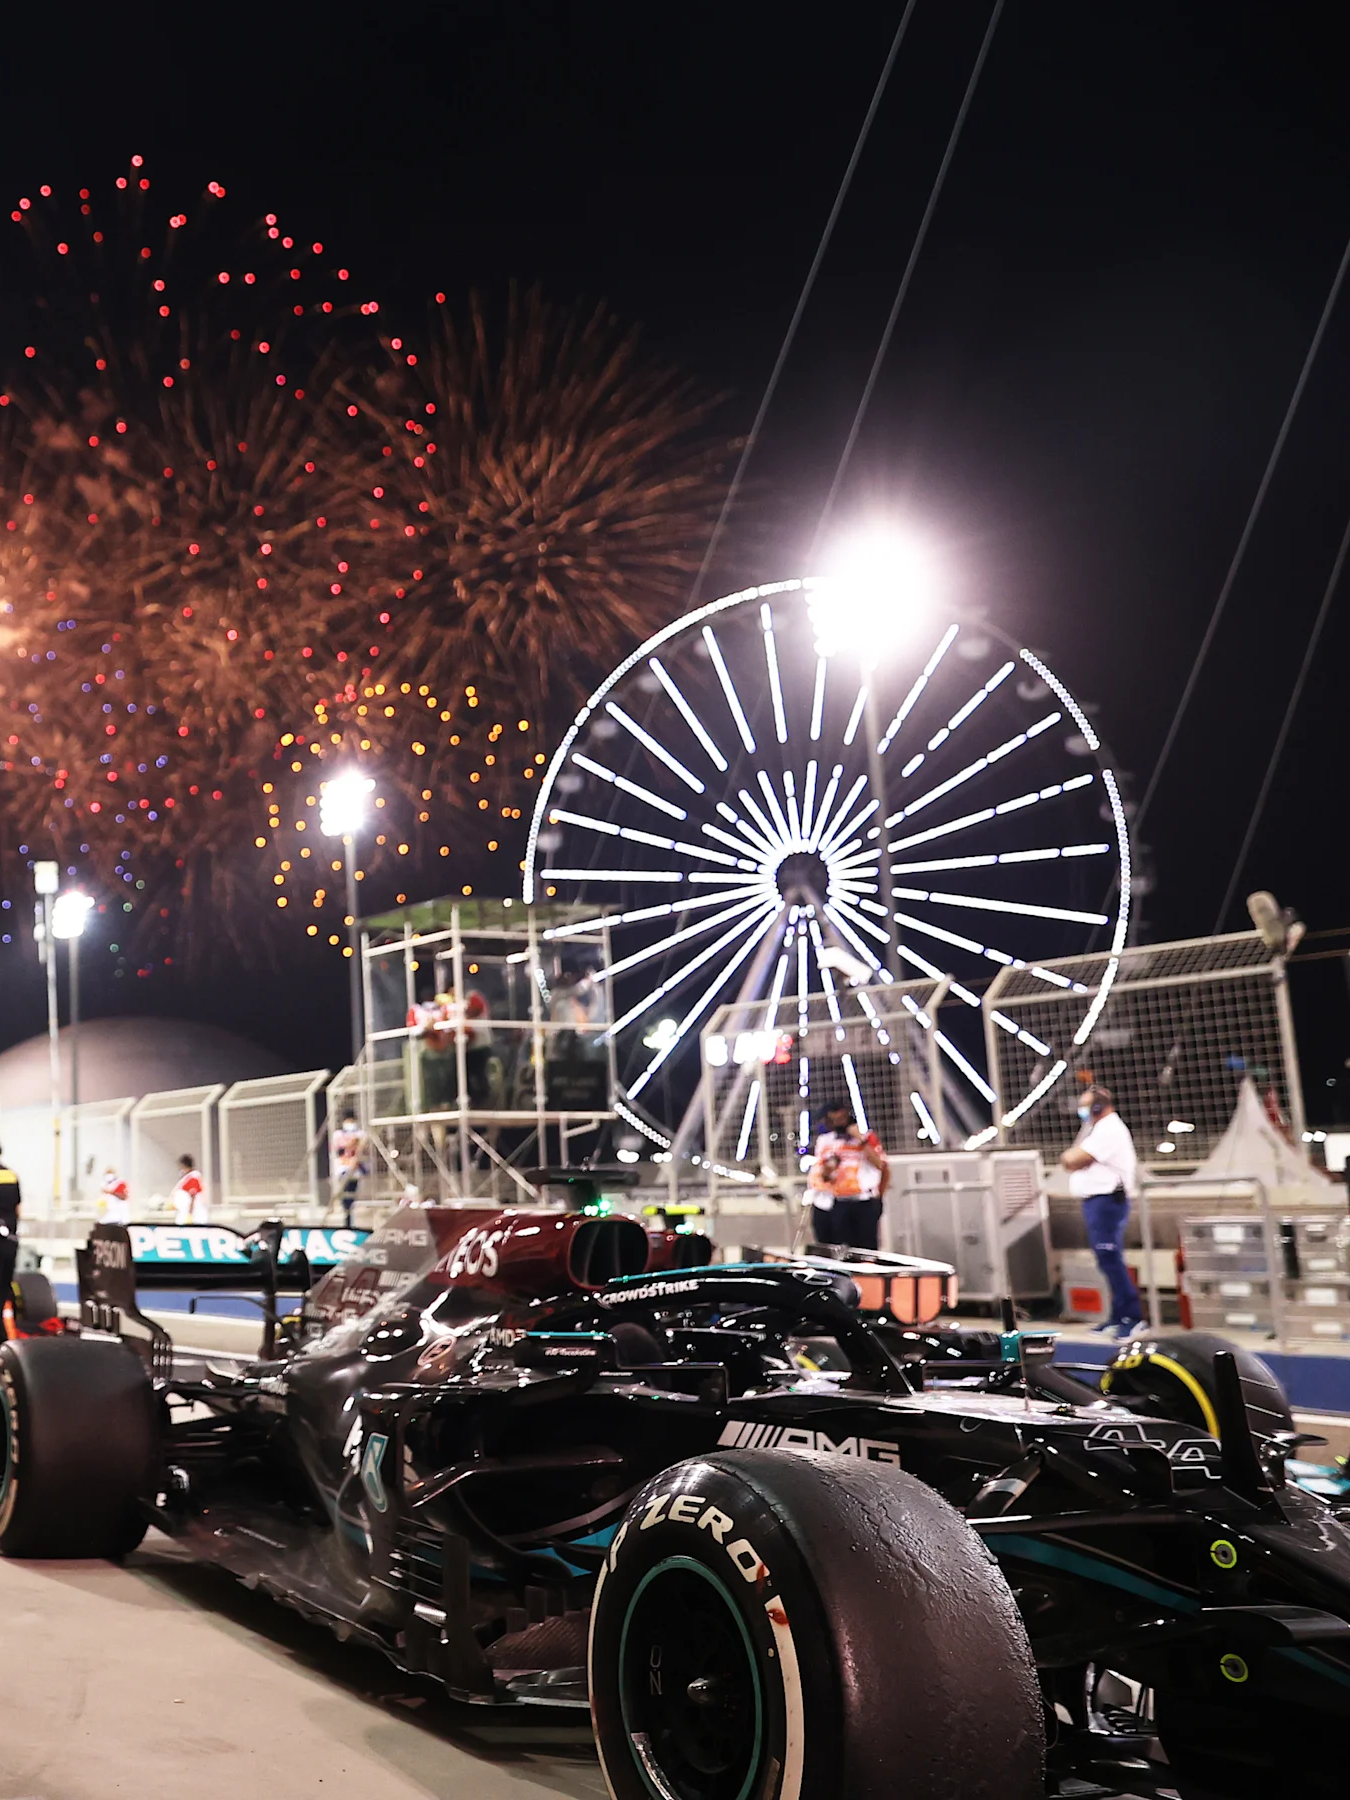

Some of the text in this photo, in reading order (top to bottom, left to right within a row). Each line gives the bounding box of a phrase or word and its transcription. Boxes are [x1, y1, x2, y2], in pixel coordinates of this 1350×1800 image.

[602, 1279, 700, 1305] CROWDSTRIKE
[776, 1427, 901, 1471] AMG
[639, 1493, 771, 1583] ZERO
